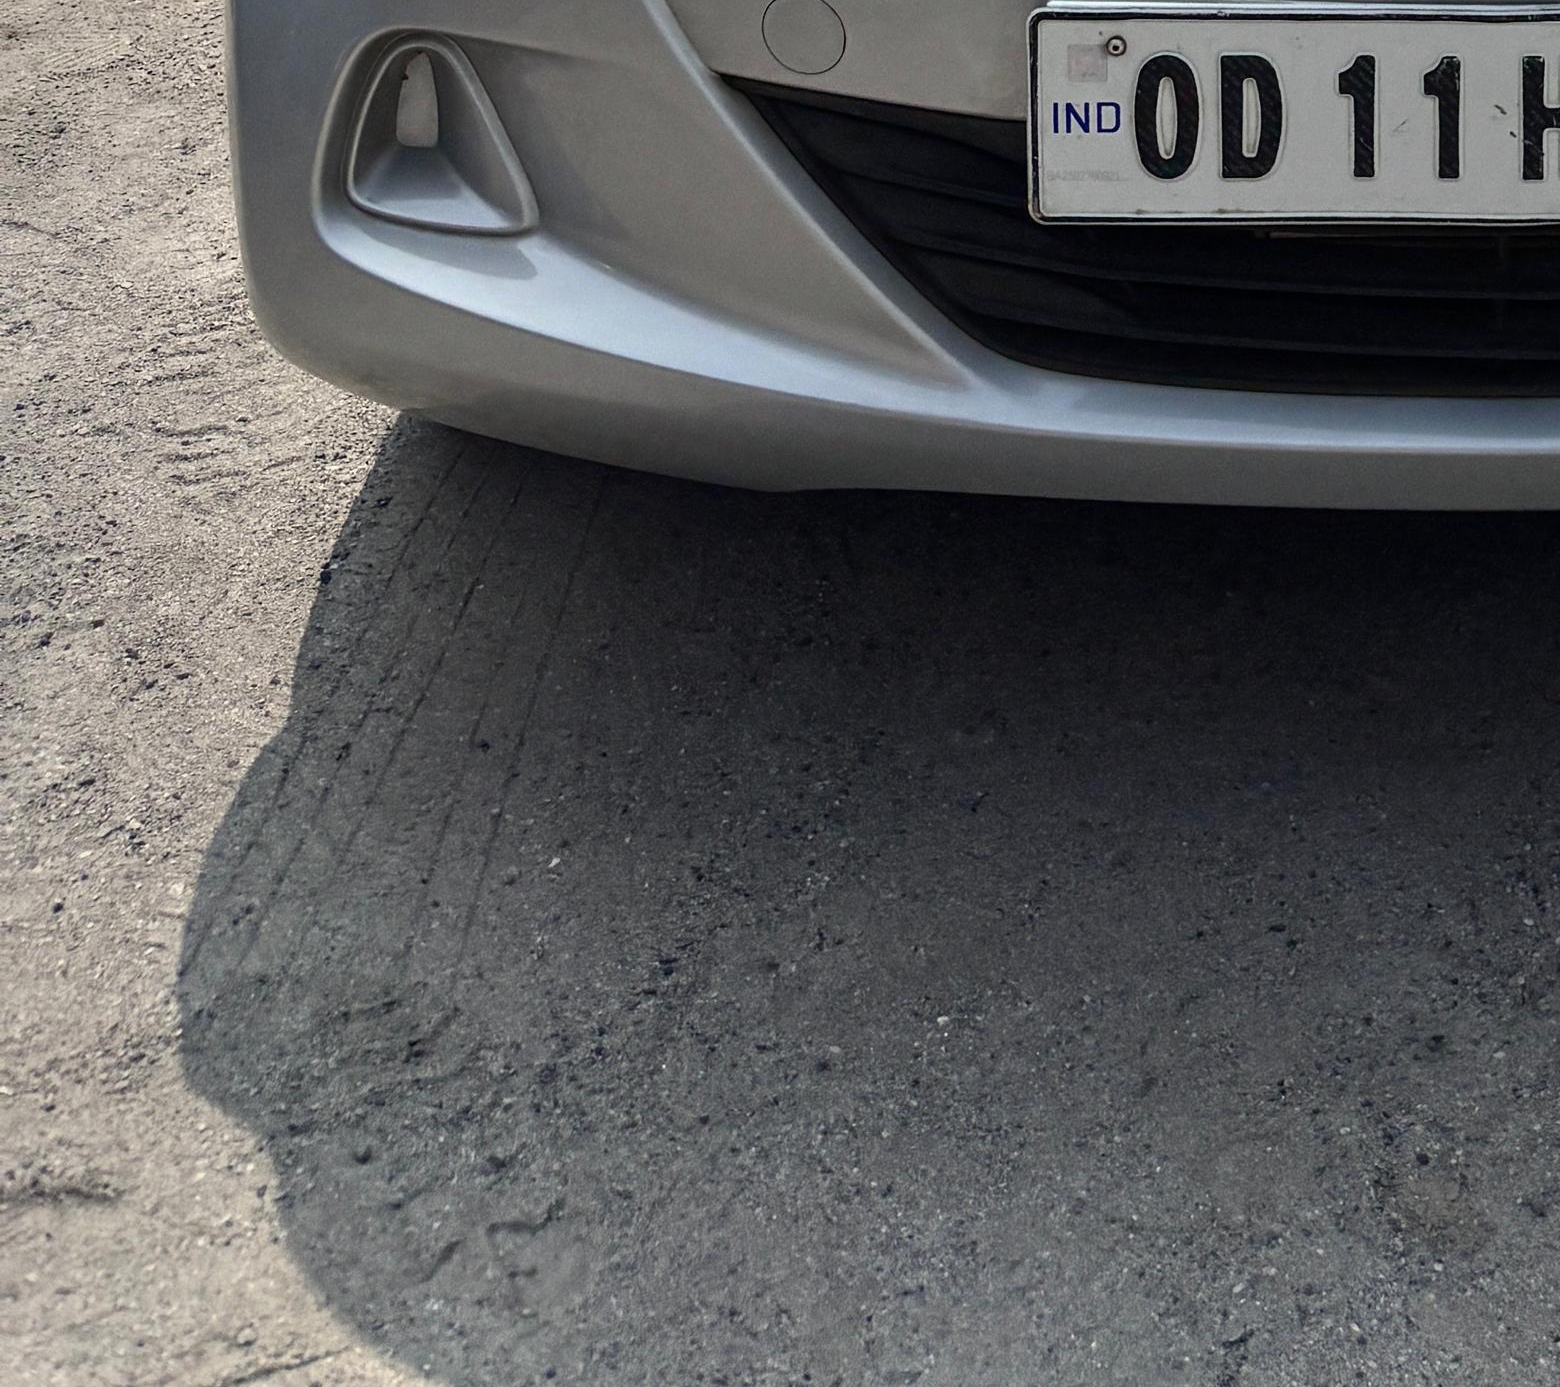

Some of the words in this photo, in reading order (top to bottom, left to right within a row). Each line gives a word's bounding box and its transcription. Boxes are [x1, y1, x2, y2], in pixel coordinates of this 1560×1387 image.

[1053, 102, 1121, 134] IND
[1131, 52, 1284, 181] OD
[1337, 53, 1460, 180] 11
